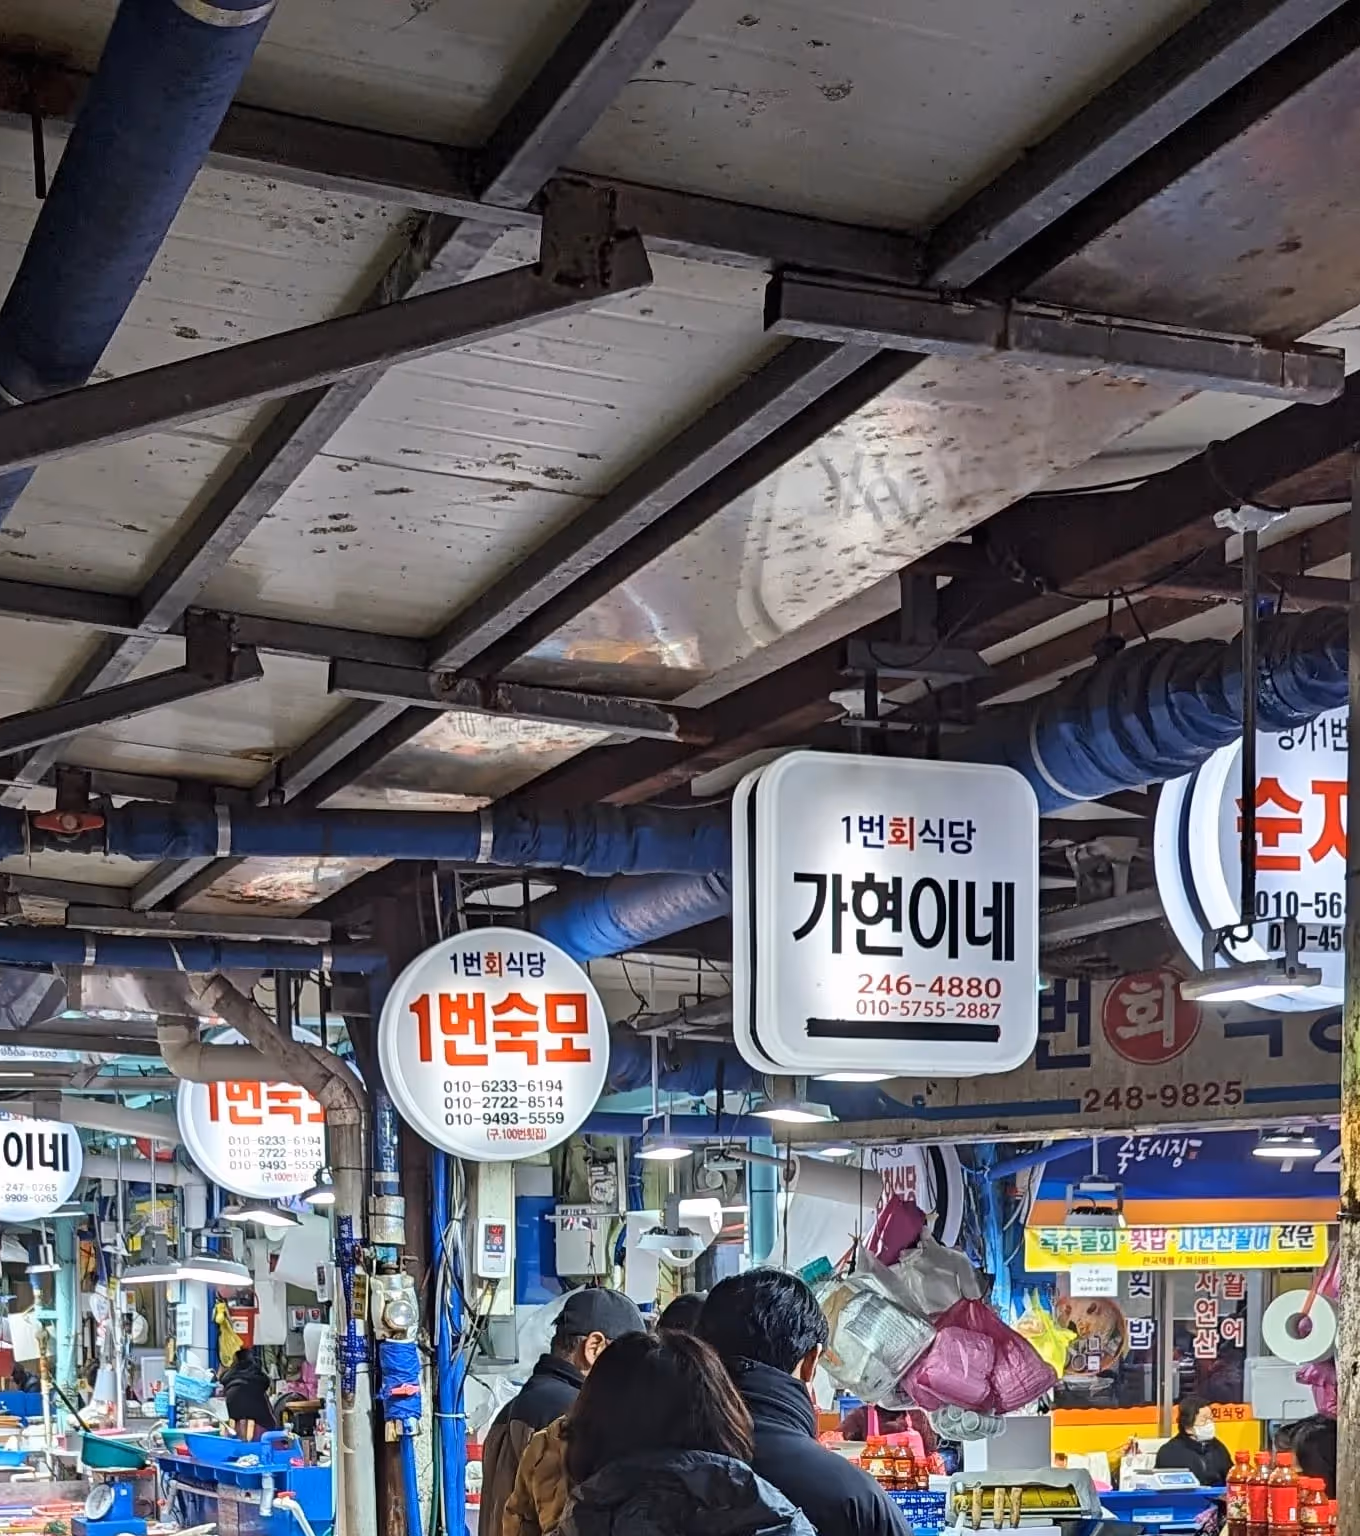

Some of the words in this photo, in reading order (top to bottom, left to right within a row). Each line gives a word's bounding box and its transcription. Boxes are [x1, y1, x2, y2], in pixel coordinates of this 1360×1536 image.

[841, 814, 976, 855] 1번회식당
[792, 871, 1015, 962] 가현이네
[1256, 890, 1349, 920] 010-56
[449, 951, 547, 979] 1번회식당
[857, 973, 1002, 999] 246-4880
[856, 999, 1002, 1020] 010-5755-2887
[408, 992, 592, 1066] 1번숙모
[444, 1079, 563, 1094] 010-6233-6194
[1083, 1080, 1242, 1113] 248-9825
[444, 1095, 564, 1111] 010-2722-8514
[444, 1111, 565, 1126] 010-9493-5559
[486, 1127, 548, 1143] (구.100번횟집)
[1117, 1138, 1192, 1174] 죽도시장
